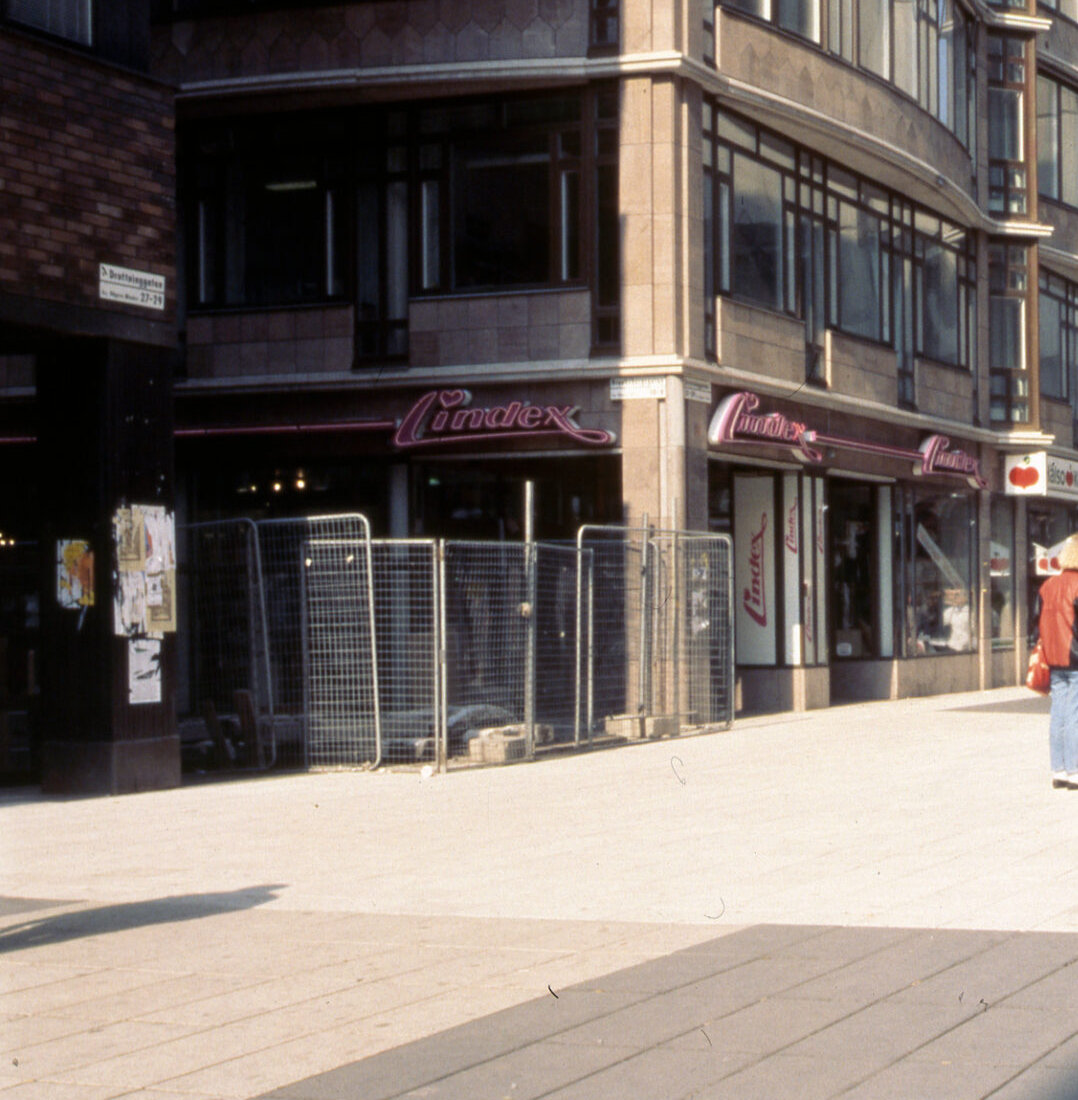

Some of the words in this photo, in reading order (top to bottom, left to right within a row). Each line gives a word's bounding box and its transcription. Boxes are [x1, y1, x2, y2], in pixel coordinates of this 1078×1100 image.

[395, 389, 612, 446] Lindex
[710, 392, 822, 462] Lindex
[918, 434, 987, 489] Lindex
[743, 511, 767, 628] Lindex
